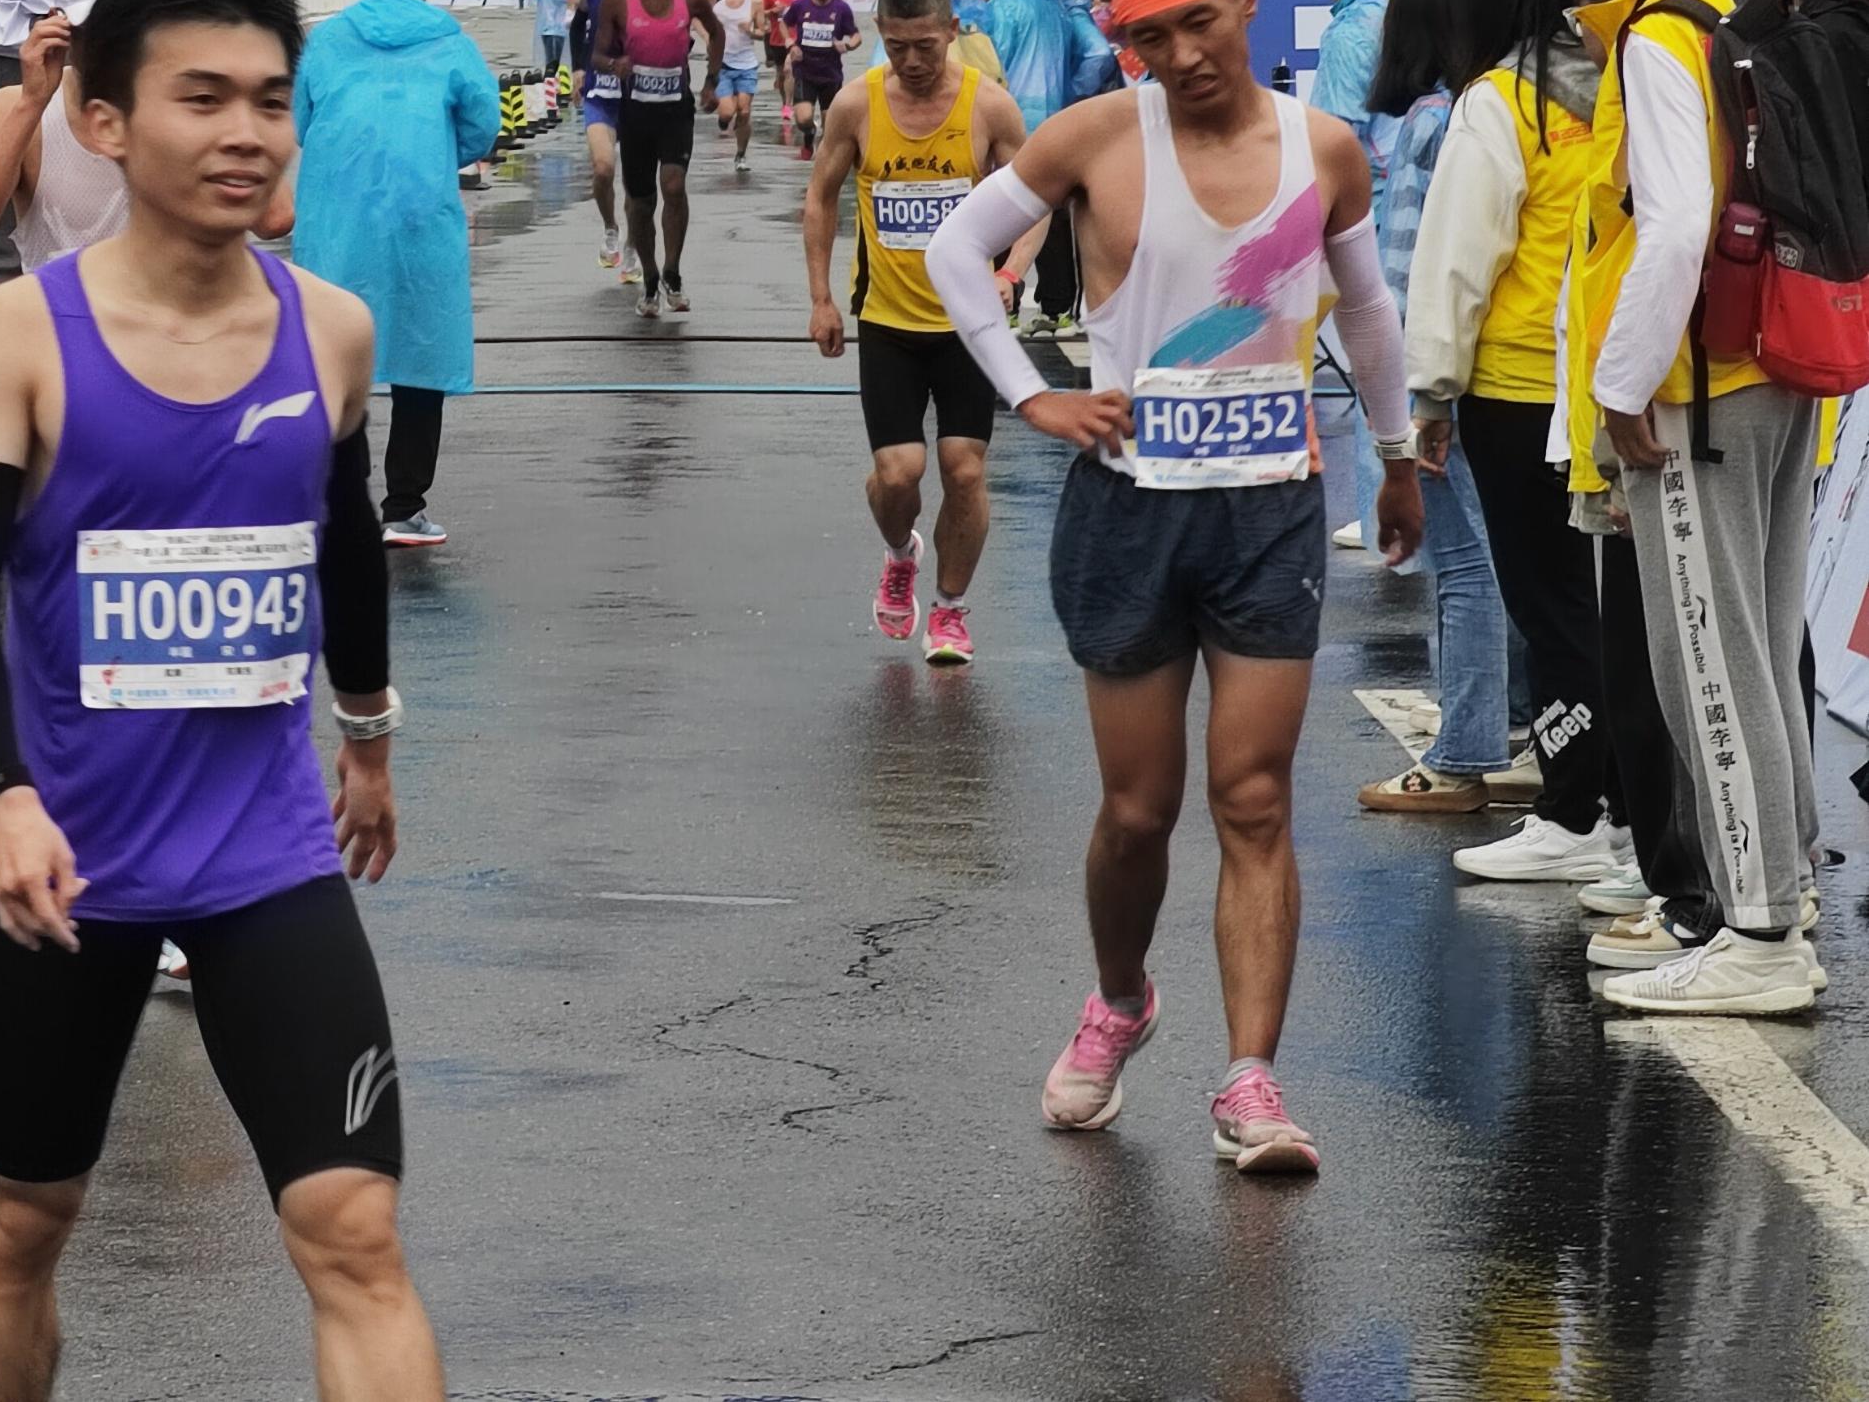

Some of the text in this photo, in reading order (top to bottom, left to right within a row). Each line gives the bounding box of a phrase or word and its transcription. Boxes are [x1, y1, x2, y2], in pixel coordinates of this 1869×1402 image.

[634, 74, 680, 93] H00219
[1143, 394, 1299, 445] H02552
[92, 572, 307, 641] H00943
[1676, 553, 1706, 675] Anything is Possible
[1539, 702, 1592, 759] Keep
[1719, 779, 1737, 832] Anything
